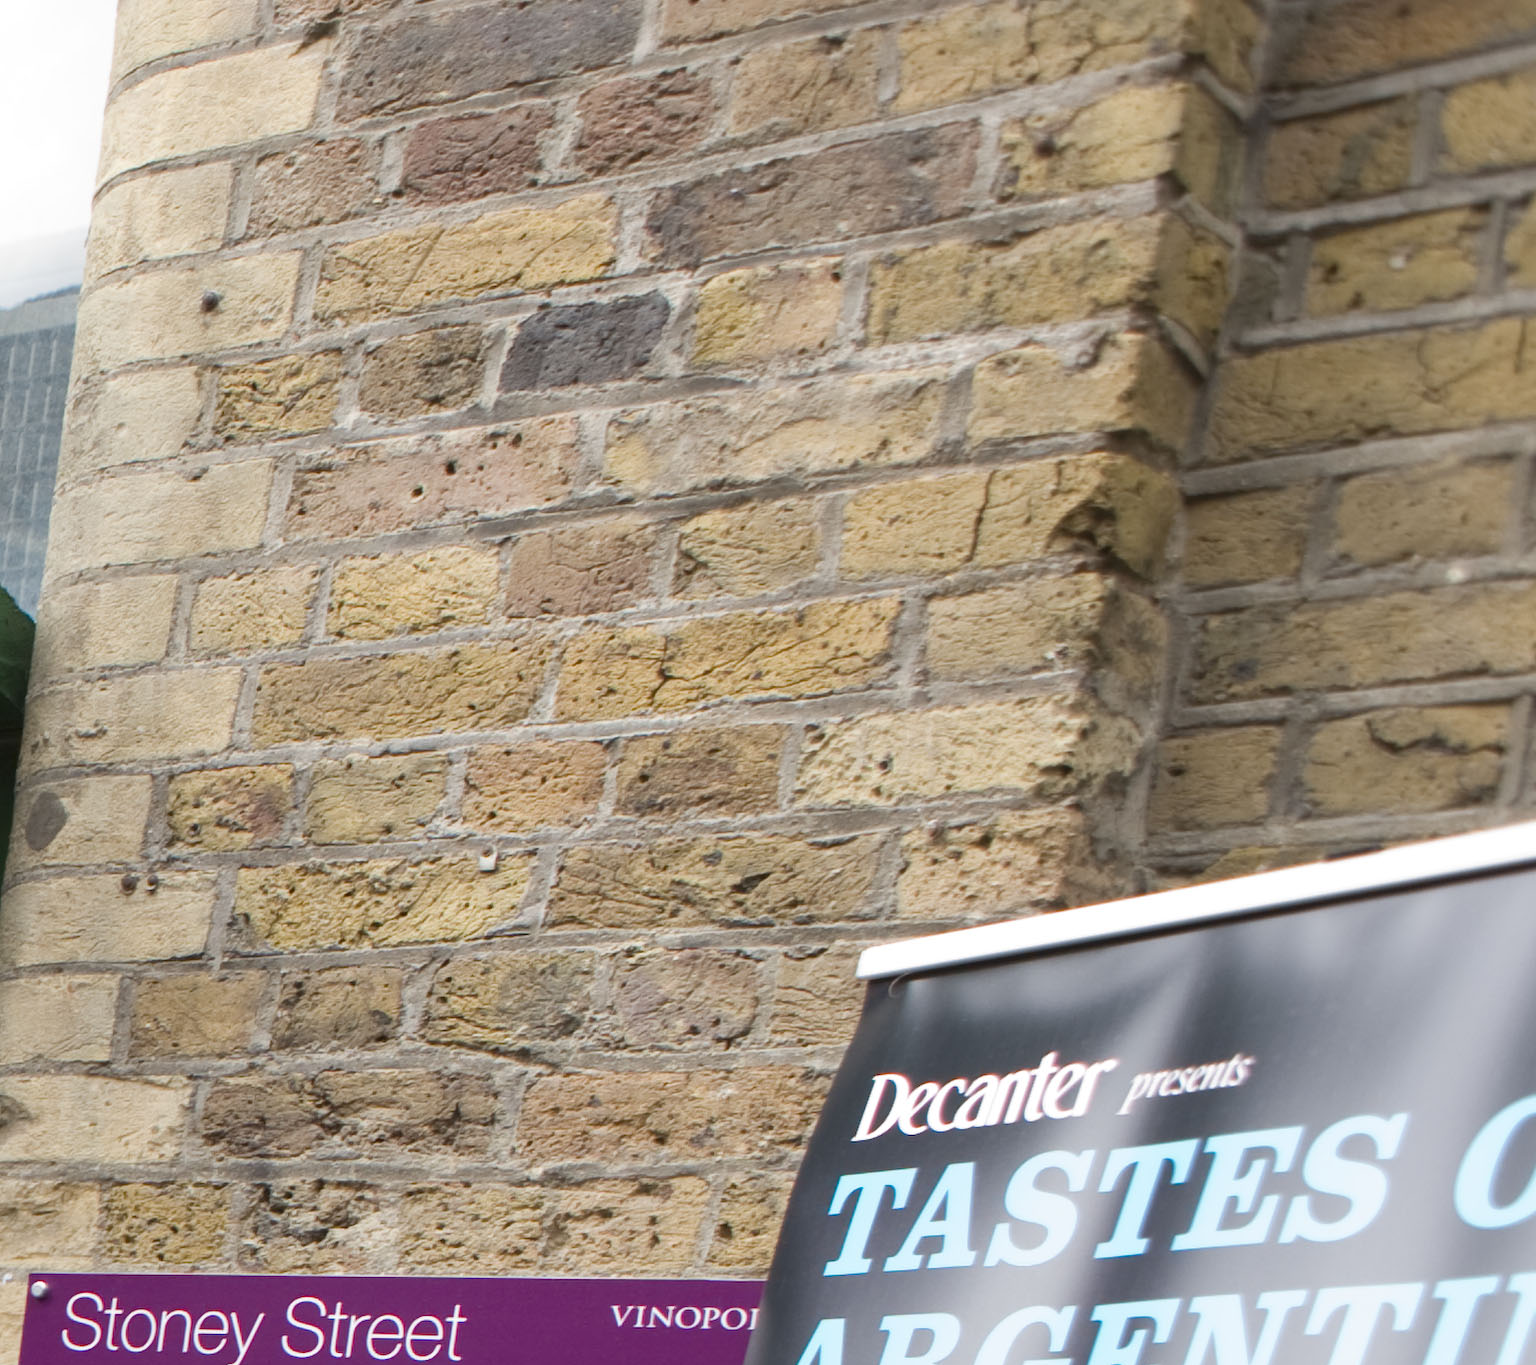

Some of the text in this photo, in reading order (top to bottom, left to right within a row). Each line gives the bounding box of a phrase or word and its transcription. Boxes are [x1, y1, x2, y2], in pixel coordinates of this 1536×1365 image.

[851, 1051, 1256, 1143] Decanter presents
[823, 1114, 1410, 1278] TASTES
[279, 1296, 468, 1364] Street
